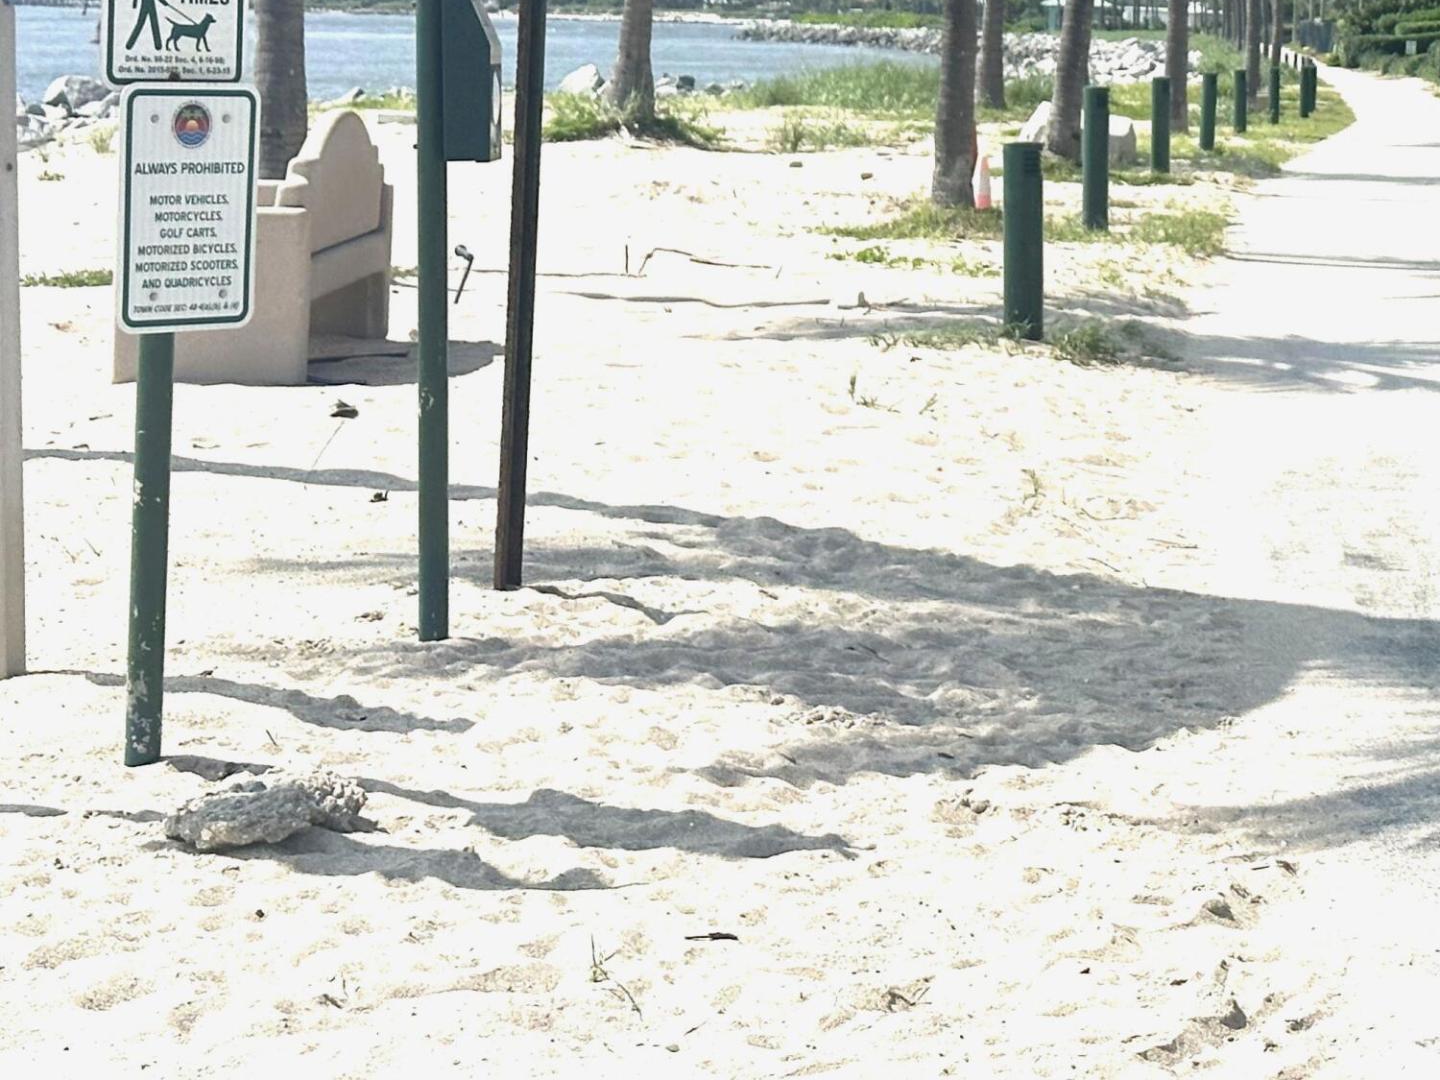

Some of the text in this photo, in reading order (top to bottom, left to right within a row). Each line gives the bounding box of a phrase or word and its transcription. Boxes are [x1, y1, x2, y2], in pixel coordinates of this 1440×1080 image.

[134, 161, 246, 175] ALWAYS PROHIBITED
[149, 194, 182, 205] MOTOR
[160, 227, 183, 239] GOLF
[137, 244, 190, 256] MOTORIZED
[135, 260, 188, 272] MOTORIZED
[142, 276, 232, 289] AND QUADRICYCLES
